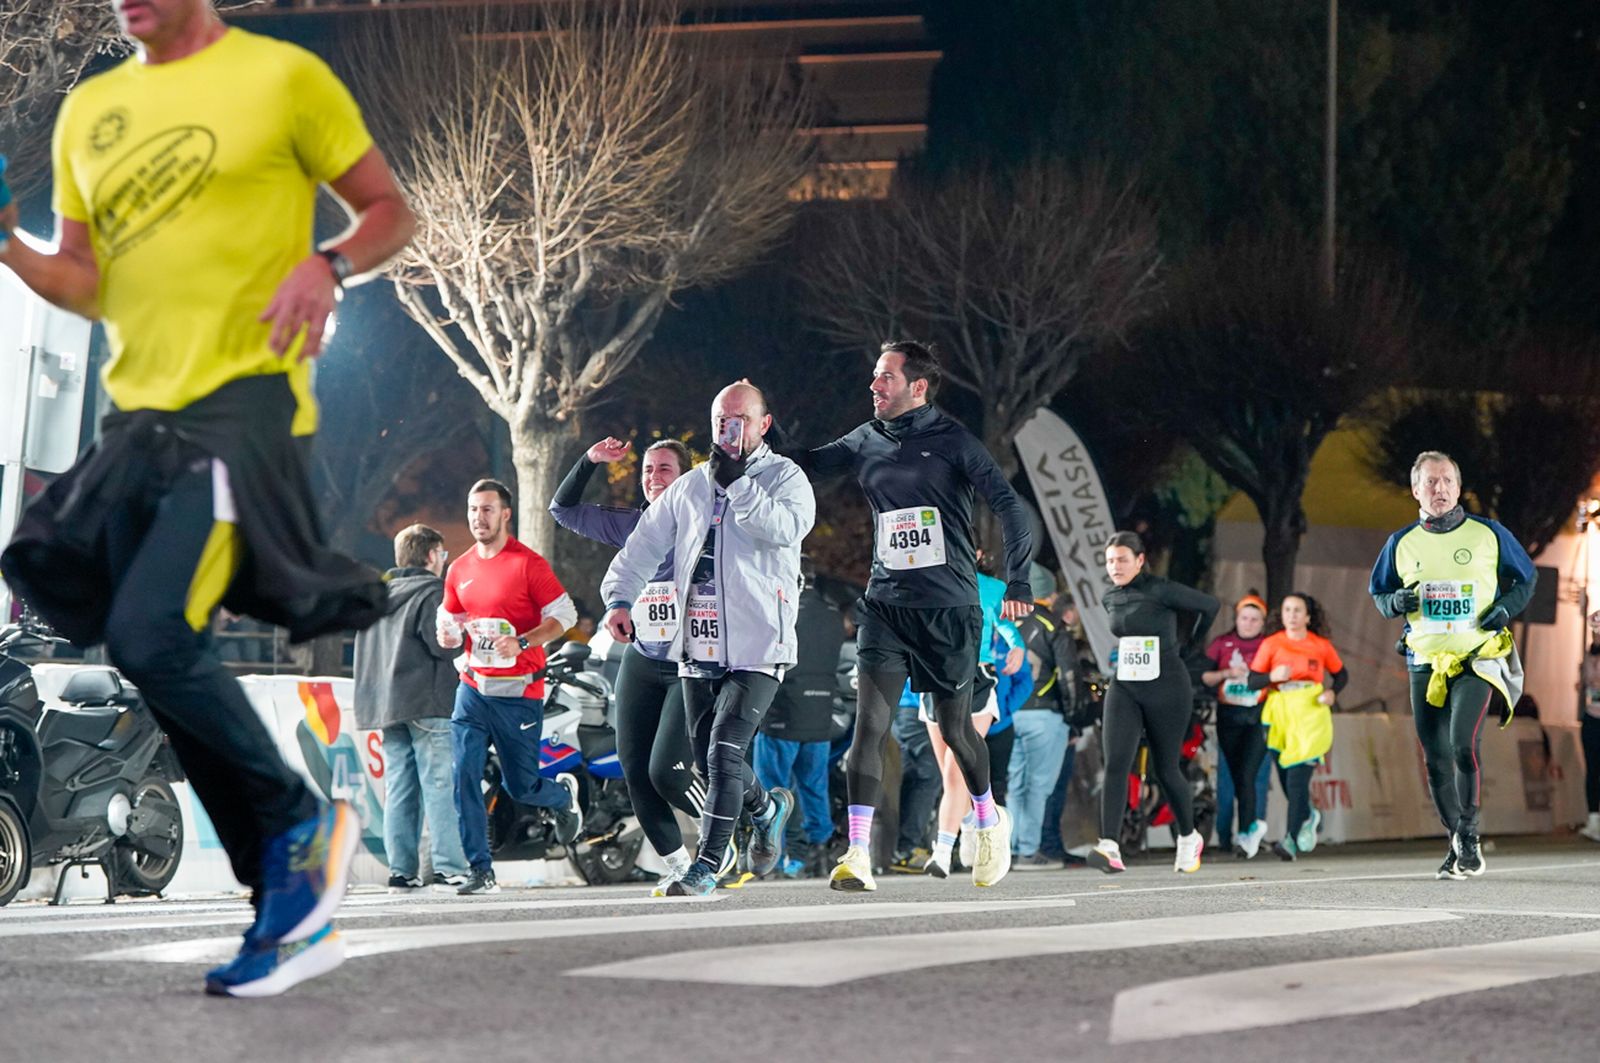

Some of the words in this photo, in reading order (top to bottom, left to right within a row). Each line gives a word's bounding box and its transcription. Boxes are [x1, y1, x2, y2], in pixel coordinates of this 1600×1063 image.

[889, 528, 932, 550] 4394
[648, 603, 677, 621] 891
[1426, 598, 1471, 616] 12989
[690, 618, 719, 639] 645
